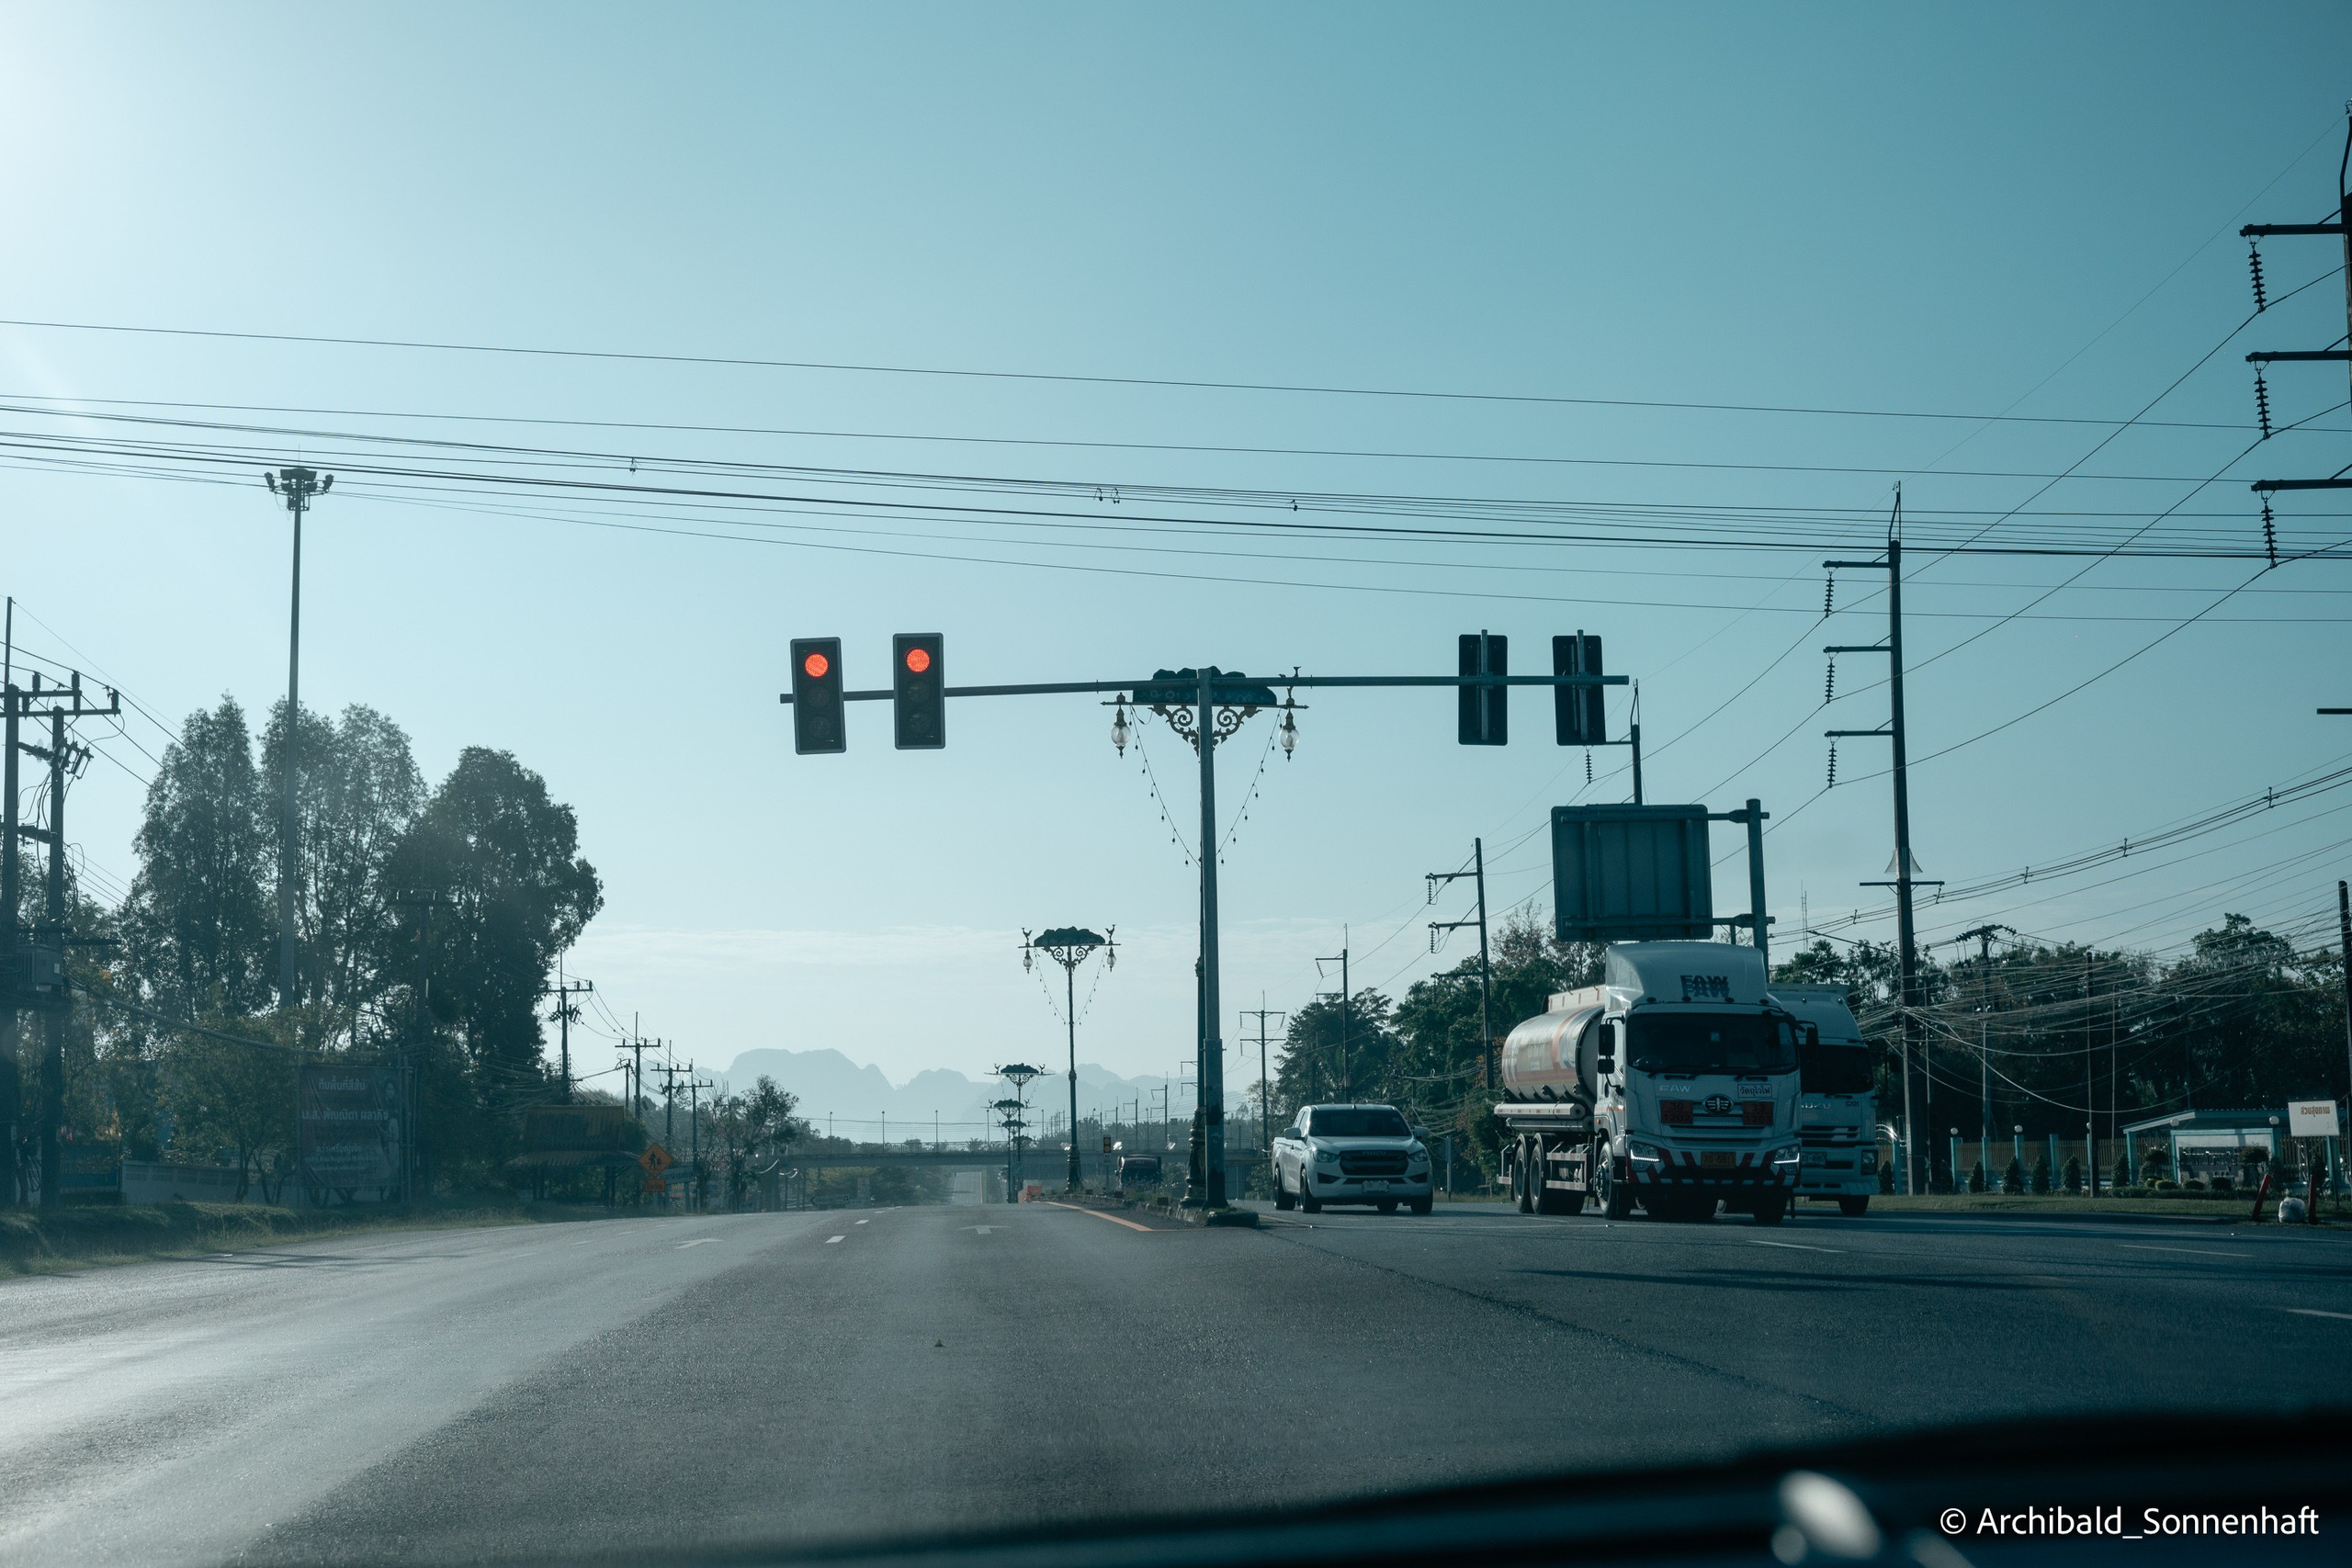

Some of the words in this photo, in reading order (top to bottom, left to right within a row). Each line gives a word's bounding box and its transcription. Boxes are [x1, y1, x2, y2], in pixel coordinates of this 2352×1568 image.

[1680, 975, 1729, 992] FAW
[1659, 1085, 1690, 1093] FAW
[1740, 1086, 1770, 1096] วัตถุไวไฟ
[1669, 1101, 1684, 1111] 30
[1751, 1103, 1766, 1111] 33
